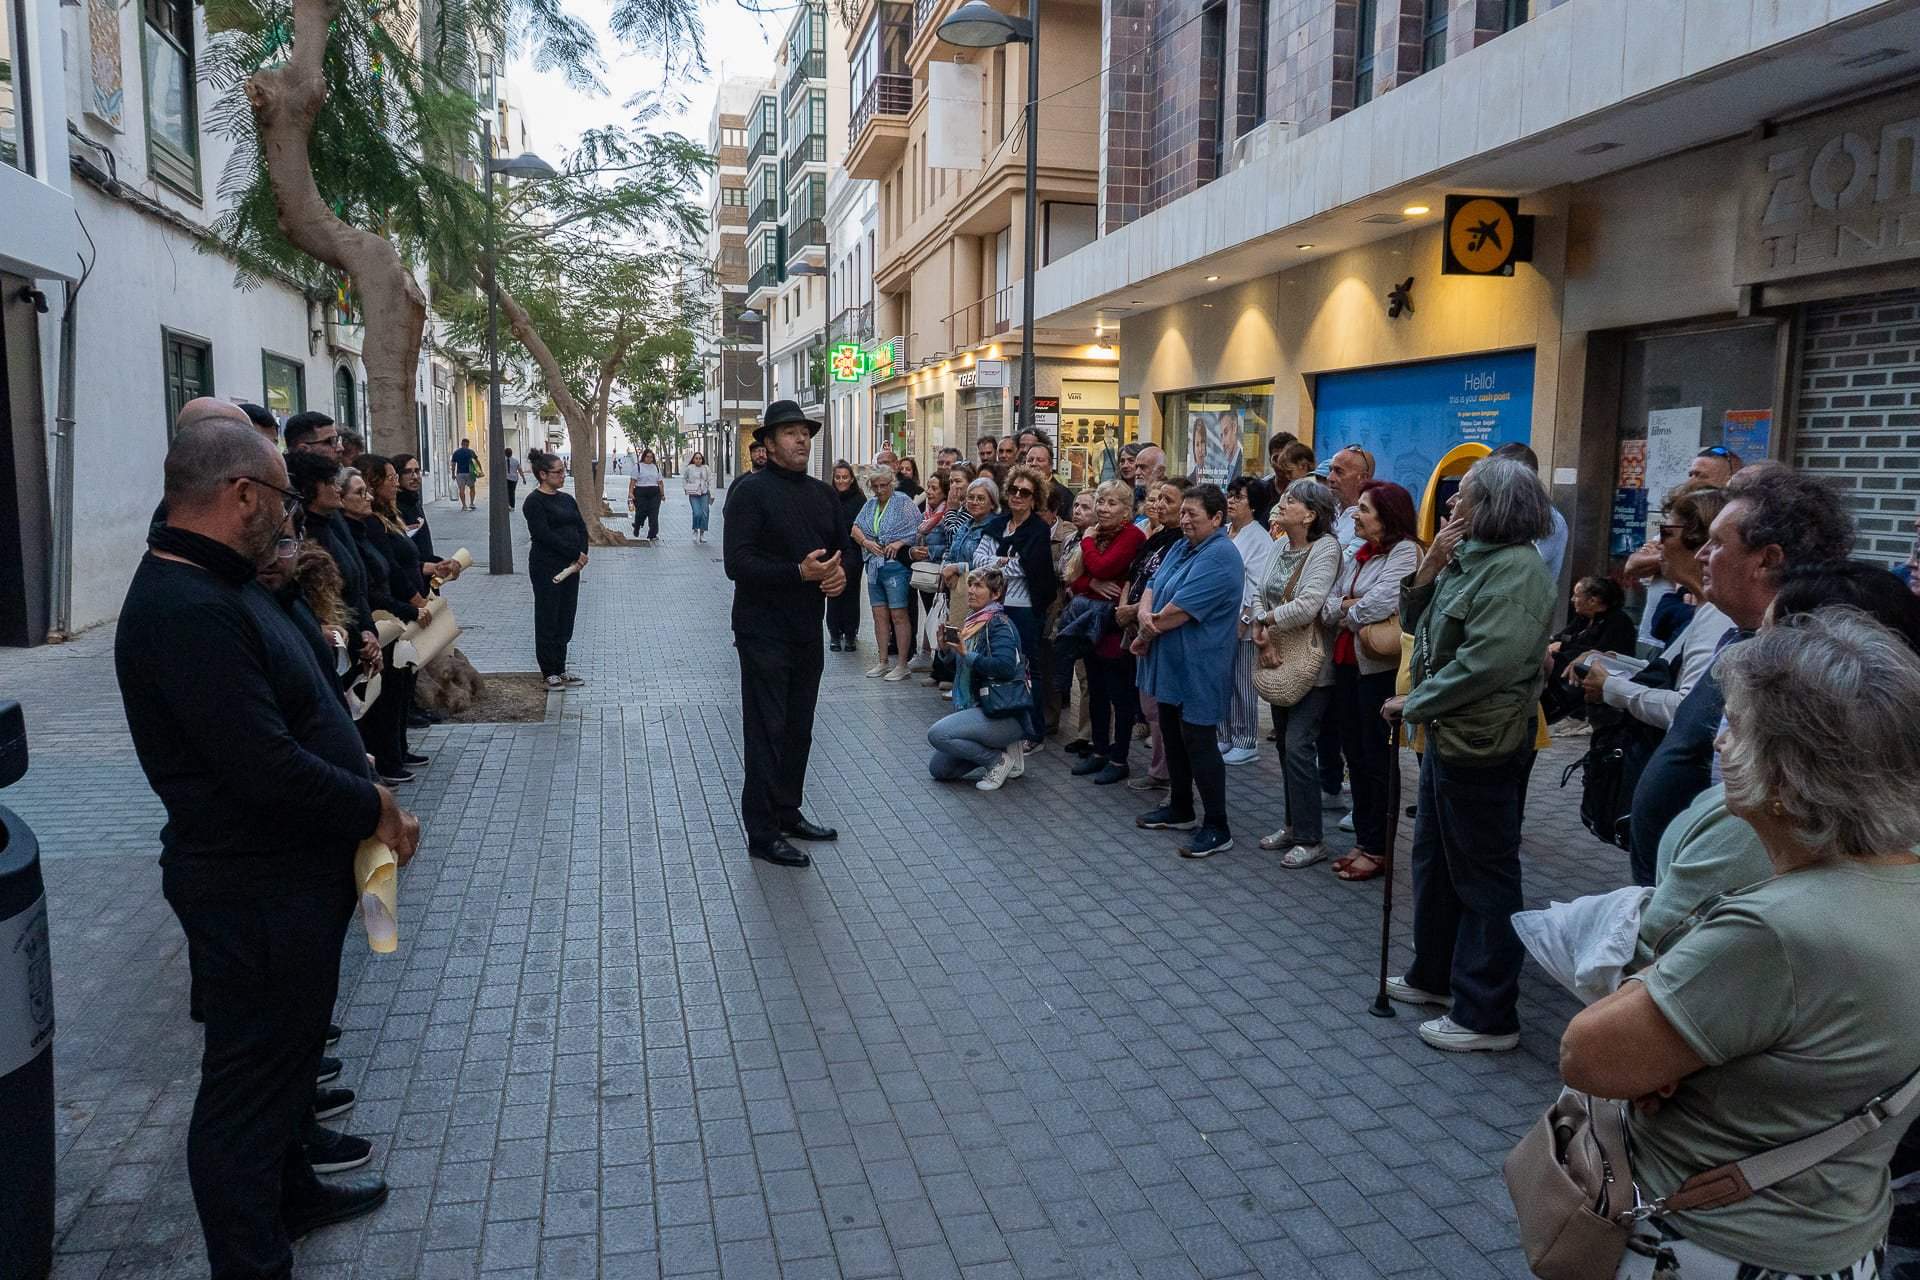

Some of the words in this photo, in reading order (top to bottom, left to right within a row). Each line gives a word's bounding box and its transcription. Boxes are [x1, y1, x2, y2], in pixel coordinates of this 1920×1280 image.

[1464, 371, 1496, 391] Hello!
[1449, 394, 1459, 404] this
[1466, 395, 1478, 405] your
[1478, 393, 1493, 402] cash
[1494, 392, 1510, 403] point
